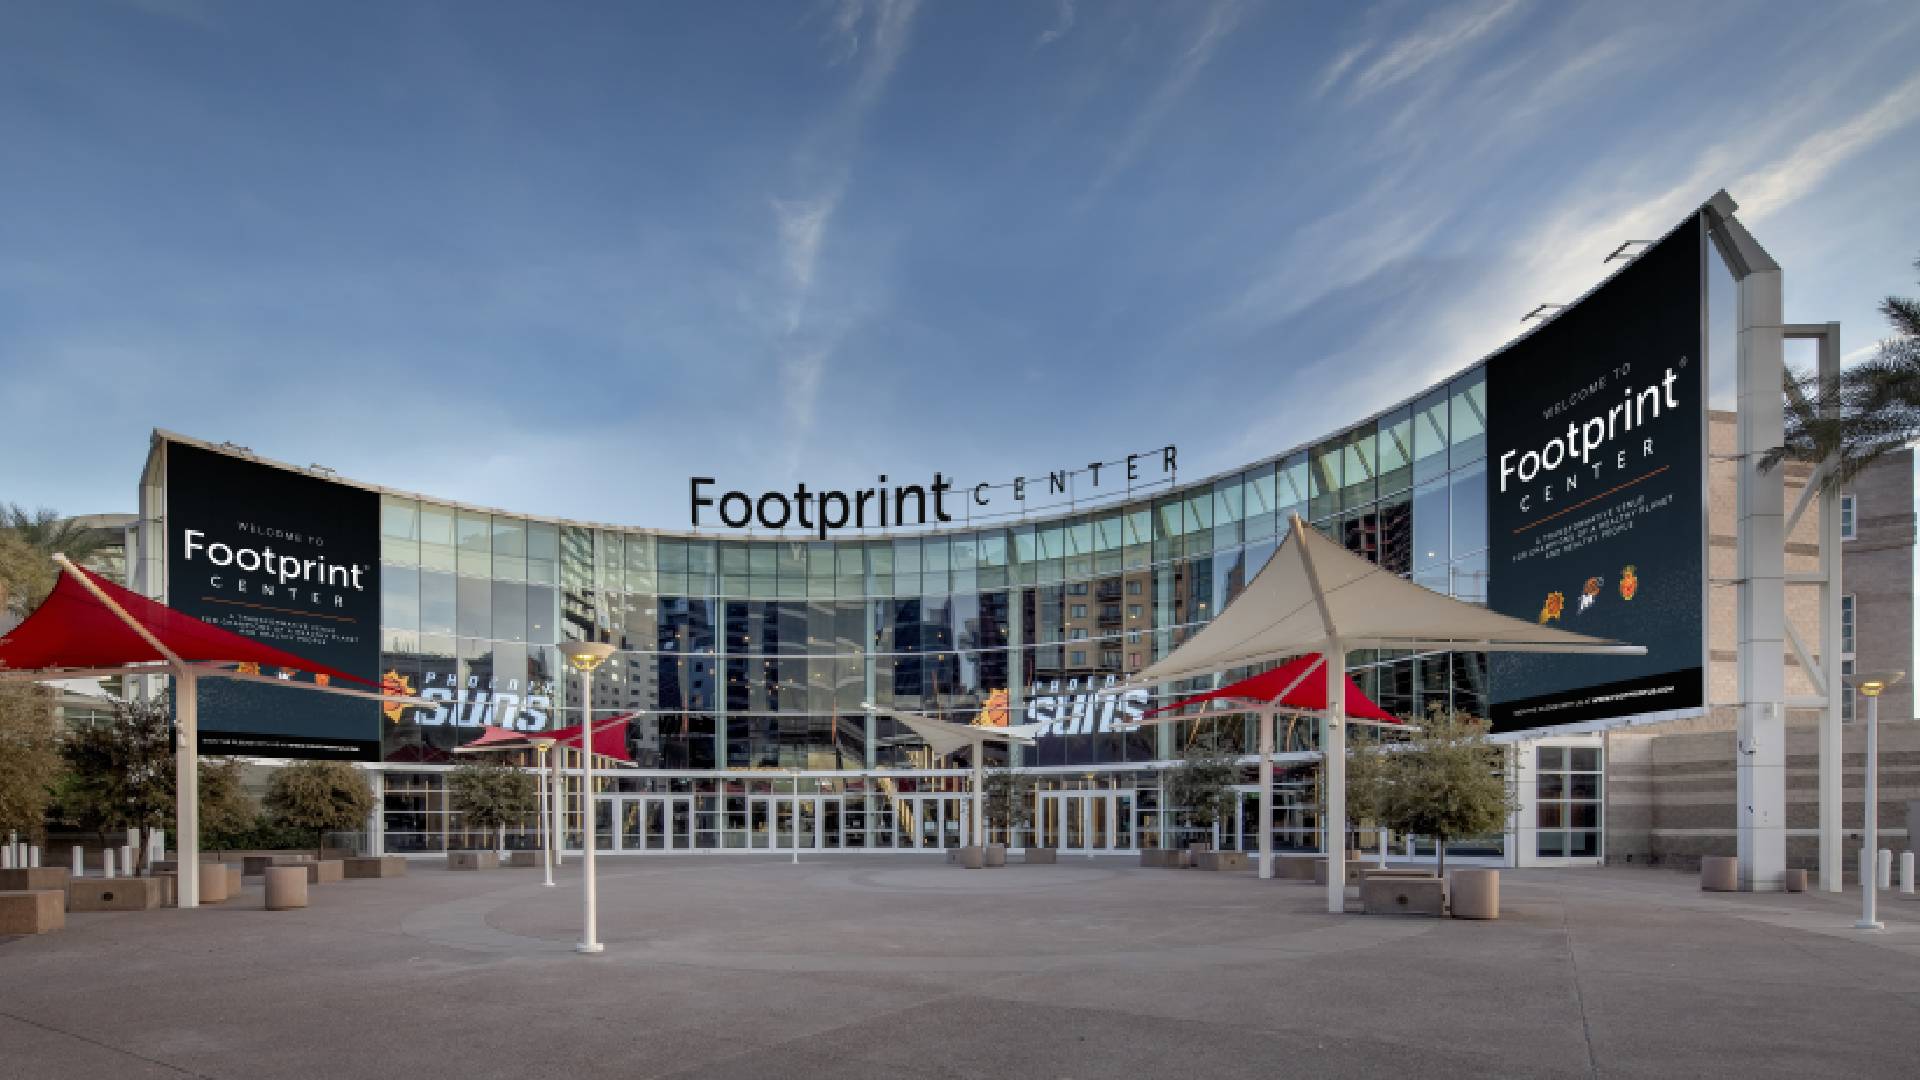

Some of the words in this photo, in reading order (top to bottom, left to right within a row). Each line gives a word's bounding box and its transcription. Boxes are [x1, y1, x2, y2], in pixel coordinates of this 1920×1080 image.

[1542, 376, 1607, 419] WELCOME
[1612, 362, 1631, 379] TO
[1500, 367, 1680, 492] Footprint
[689, 472, 951, 540] Footprint
[973, 444, 1178, 506] CENTER
[1520, 437, 1654, 512] CENTER
[184, 529, 364, 592] Footprint
[238, 521, 301, 543] WELCOME
[308, 535, 325, 547] TO
[210, 575, 343, 608] CENTER
